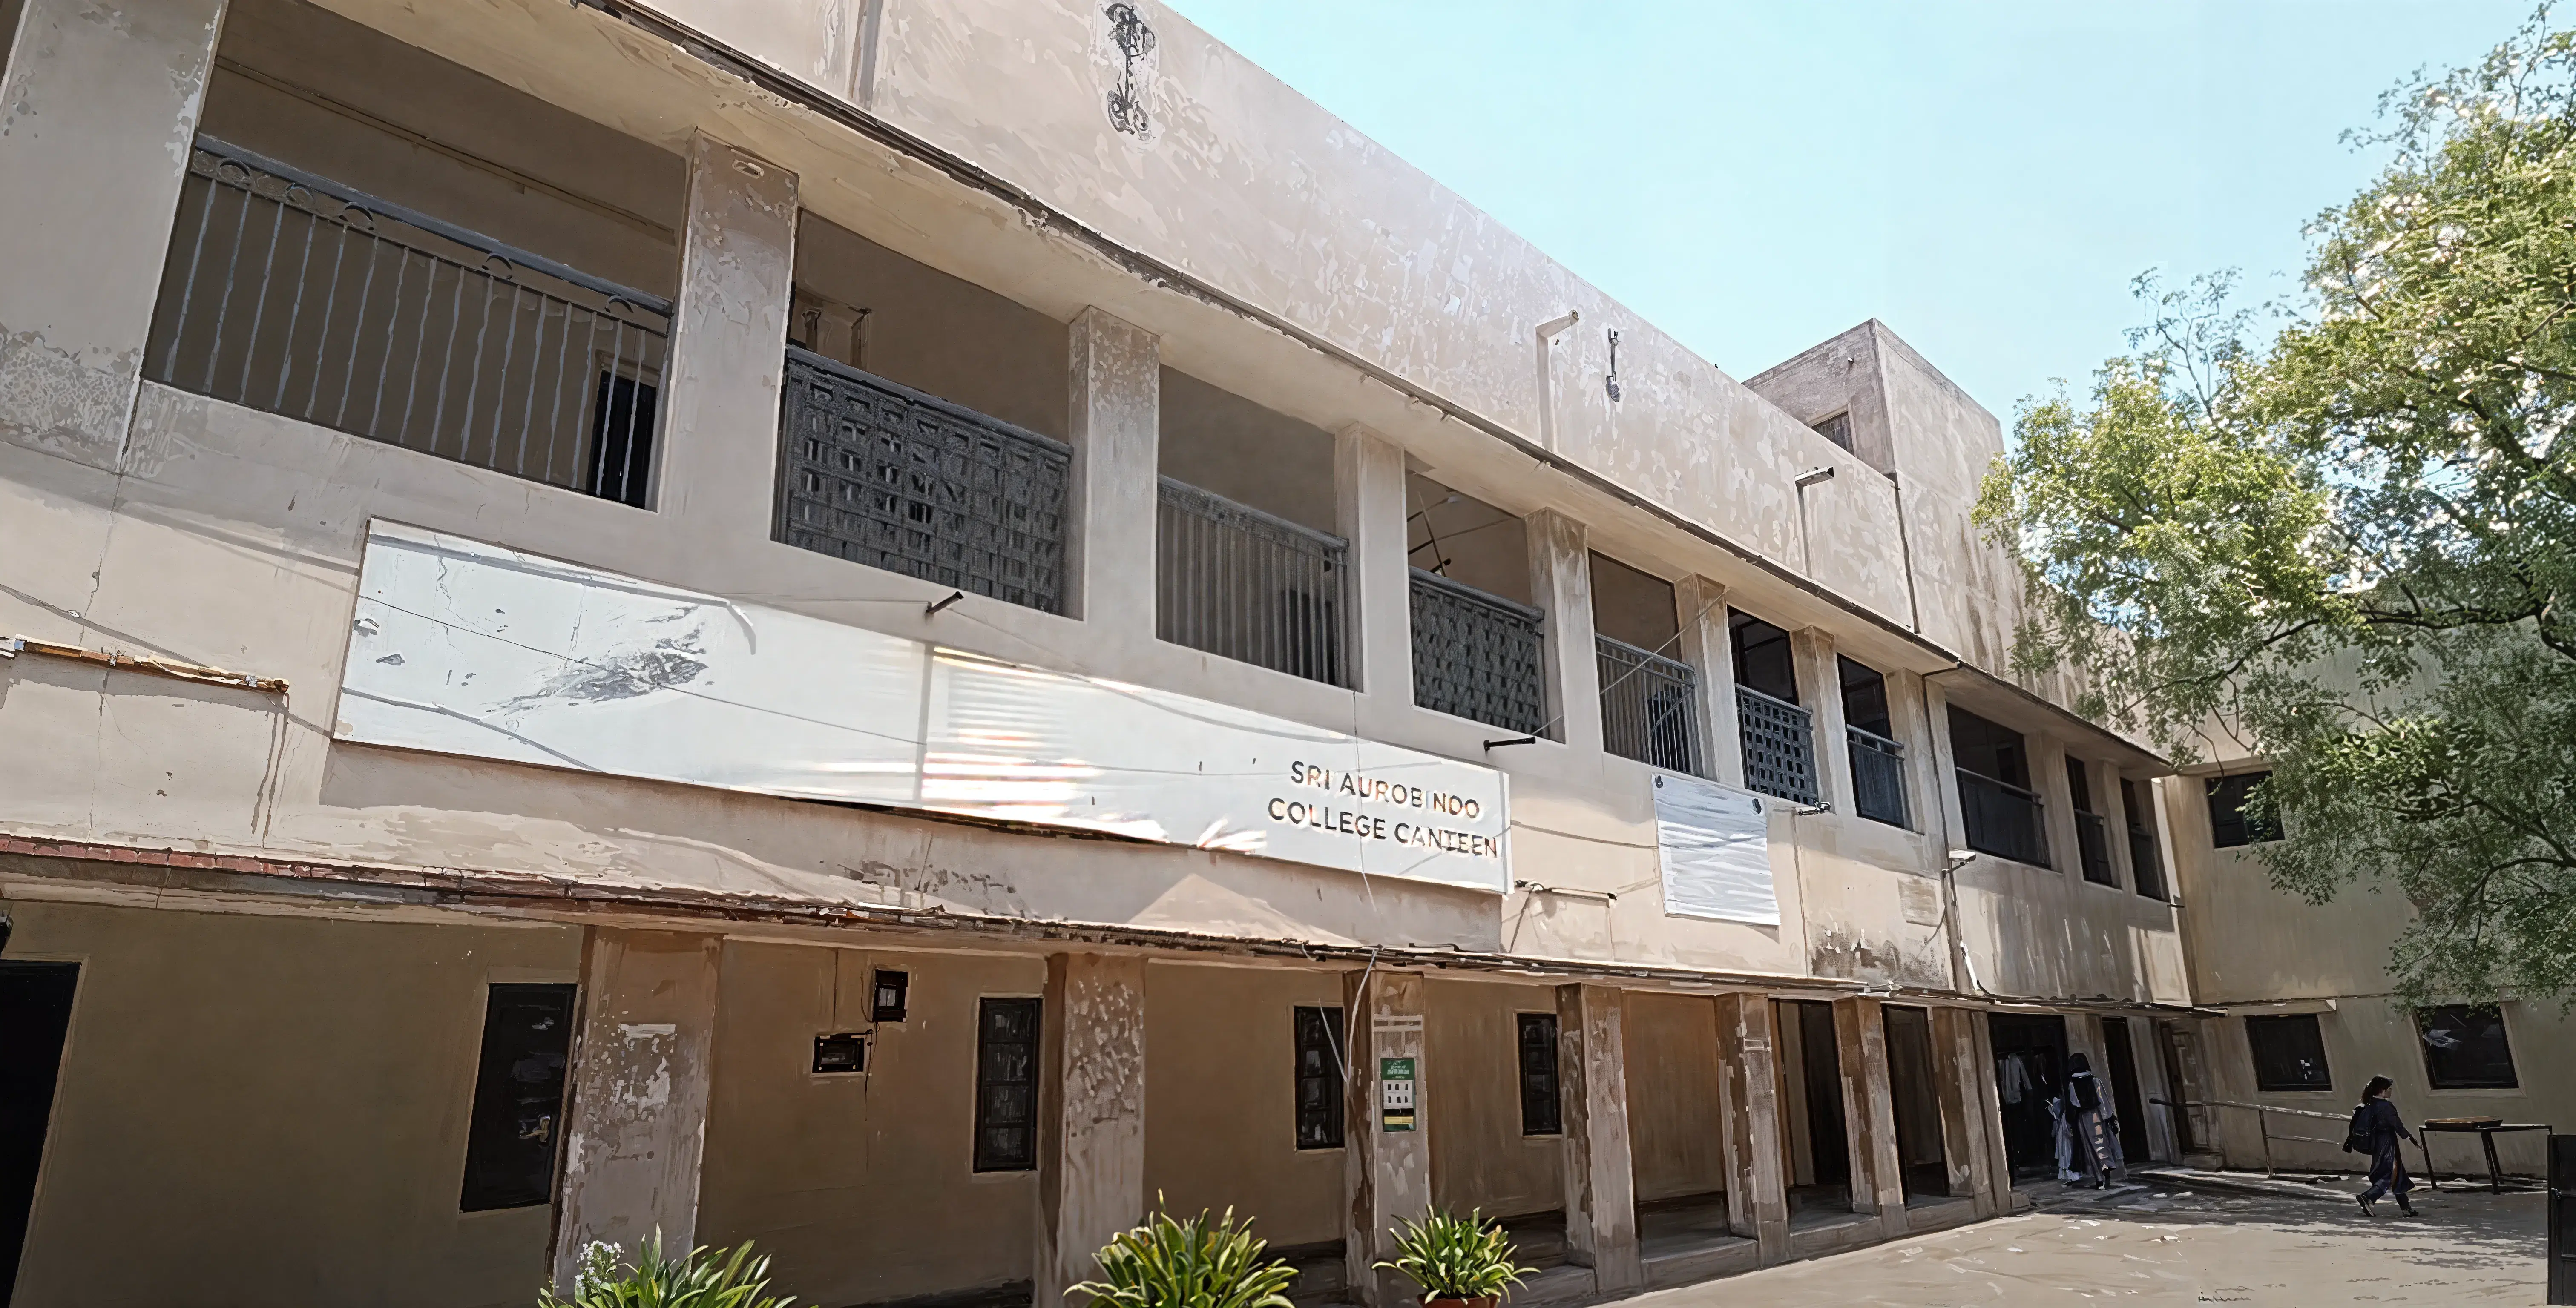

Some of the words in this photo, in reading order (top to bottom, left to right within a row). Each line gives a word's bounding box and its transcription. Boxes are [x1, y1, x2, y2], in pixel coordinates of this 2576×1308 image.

[1291, 761, 1330, 790] SRI
[1340, 773, 1480, 819] AUROBNDO
[1268, 798, 1386, 840] COLLEGE
[1394, 823, 1498, 858] CANTEEN
